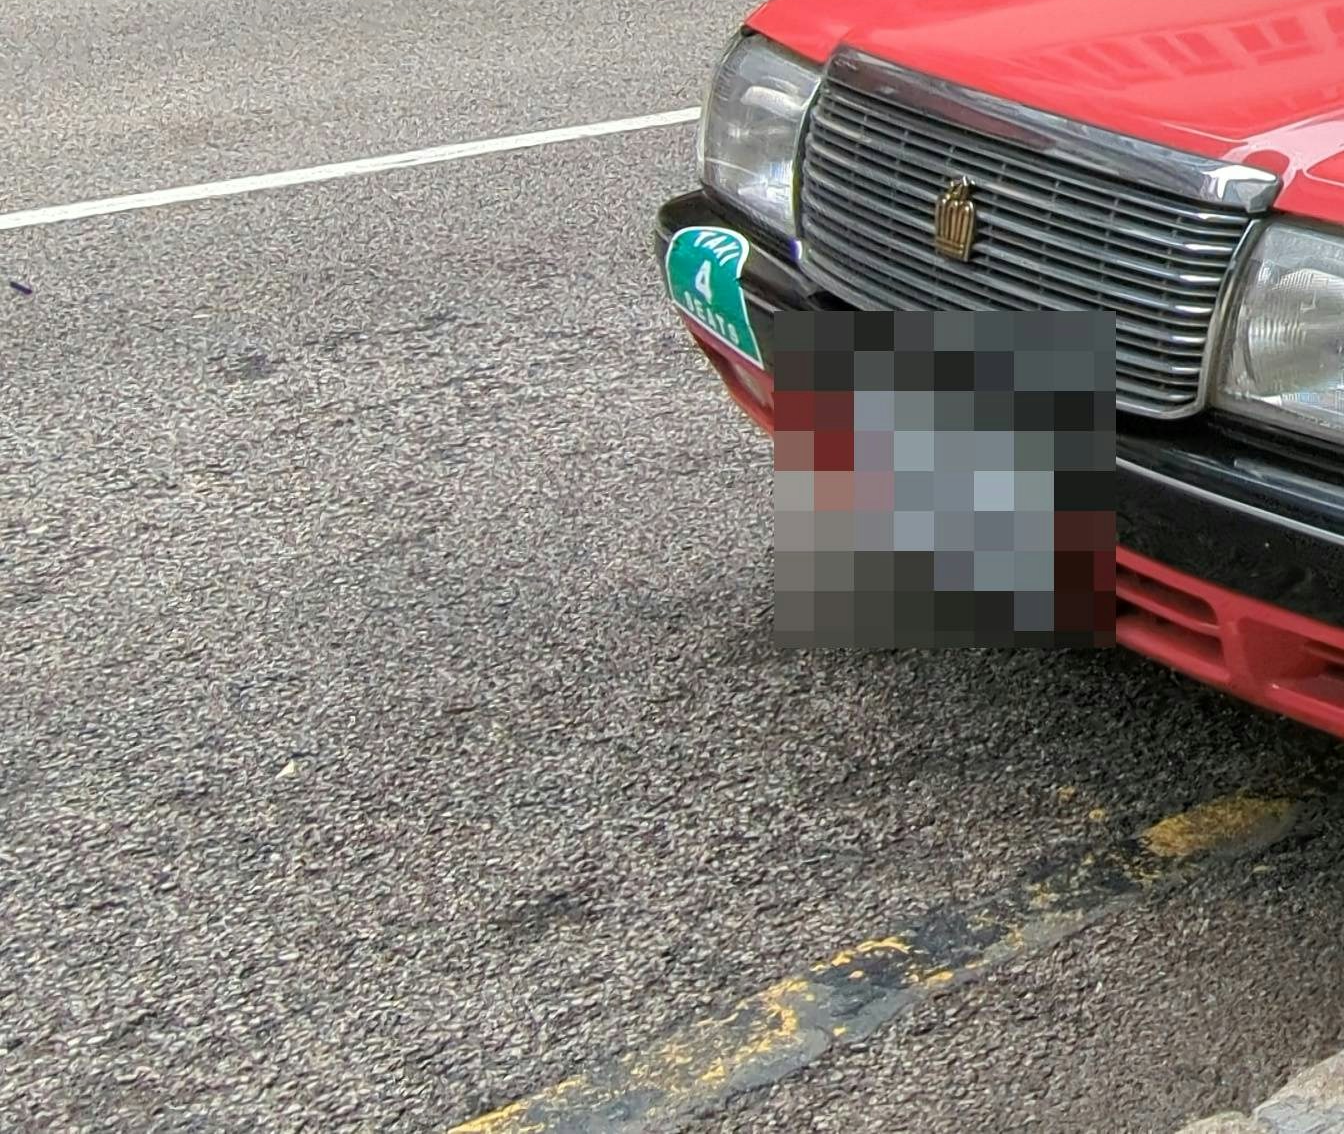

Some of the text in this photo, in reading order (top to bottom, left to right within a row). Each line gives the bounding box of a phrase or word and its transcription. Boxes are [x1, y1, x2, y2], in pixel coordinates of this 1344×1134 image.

[694, 231, 739, 266] TAXI
[695, 260, 712, 304] 4
[684, 290, 739, 345] SEATS
